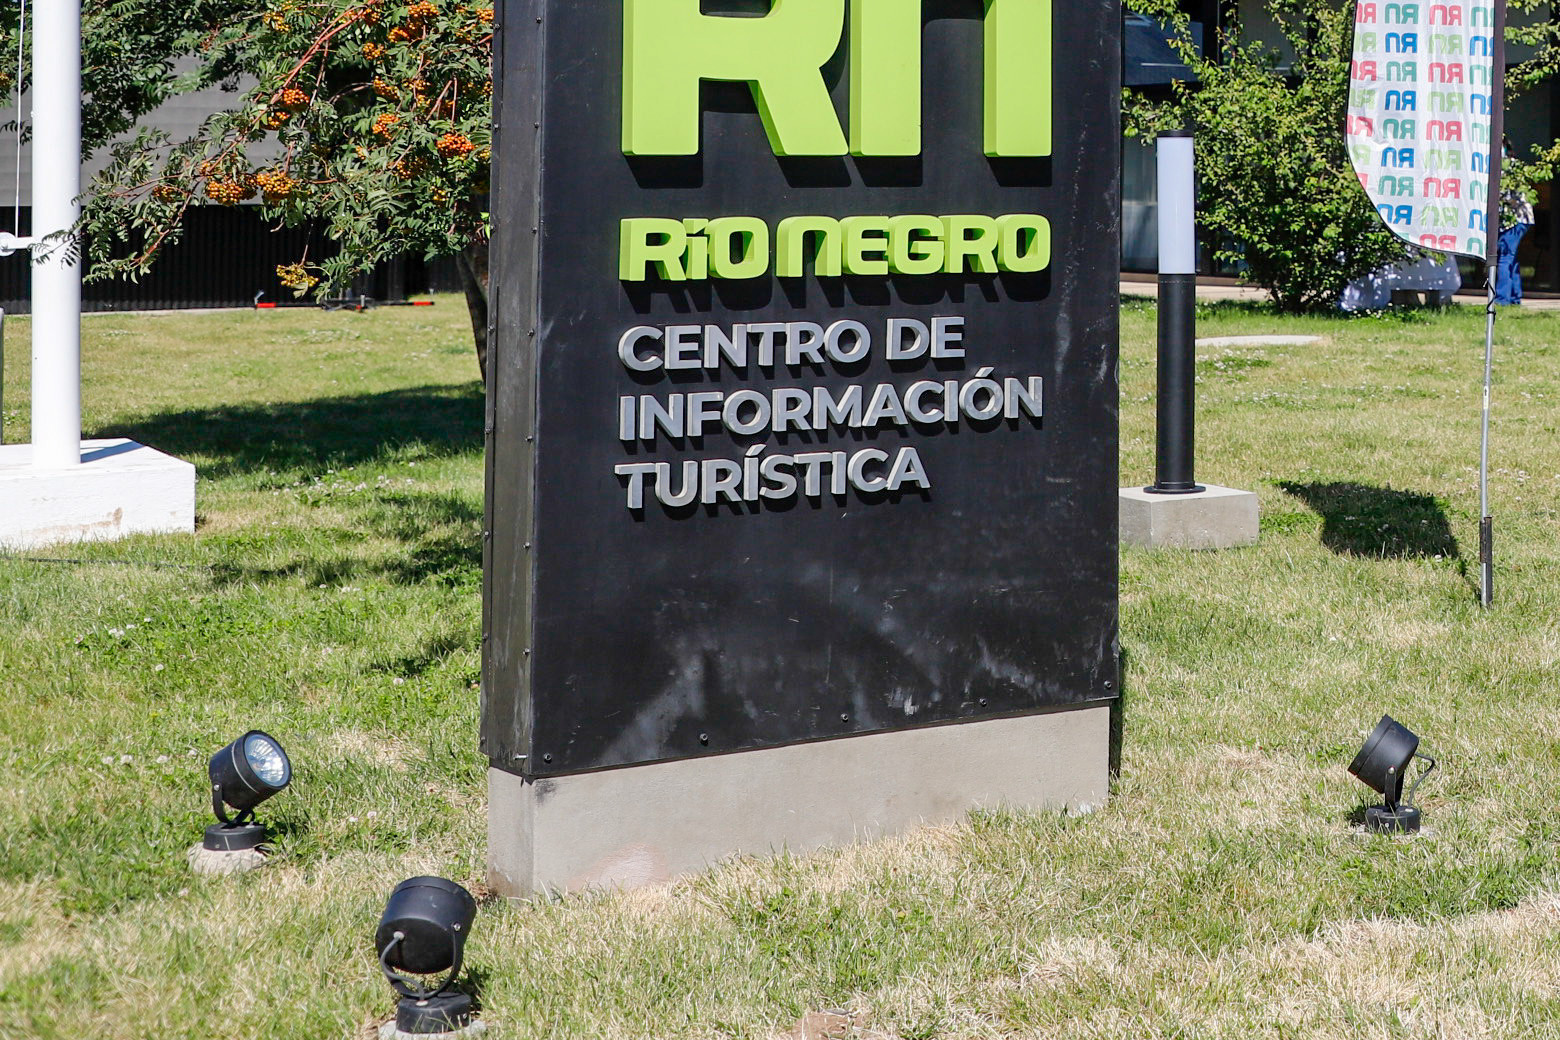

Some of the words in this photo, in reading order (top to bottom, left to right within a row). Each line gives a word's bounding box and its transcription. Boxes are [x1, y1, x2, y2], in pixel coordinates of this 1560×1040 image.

[776, 214, 1051, 277] NEGRO
[617, 319, 871, 372] CENTRO
[885, 315, 966, 360] DE
[618, 366, 1044, 442] INFORMACIÓN
[614, 443, 931, 511] TURÍSTICA
